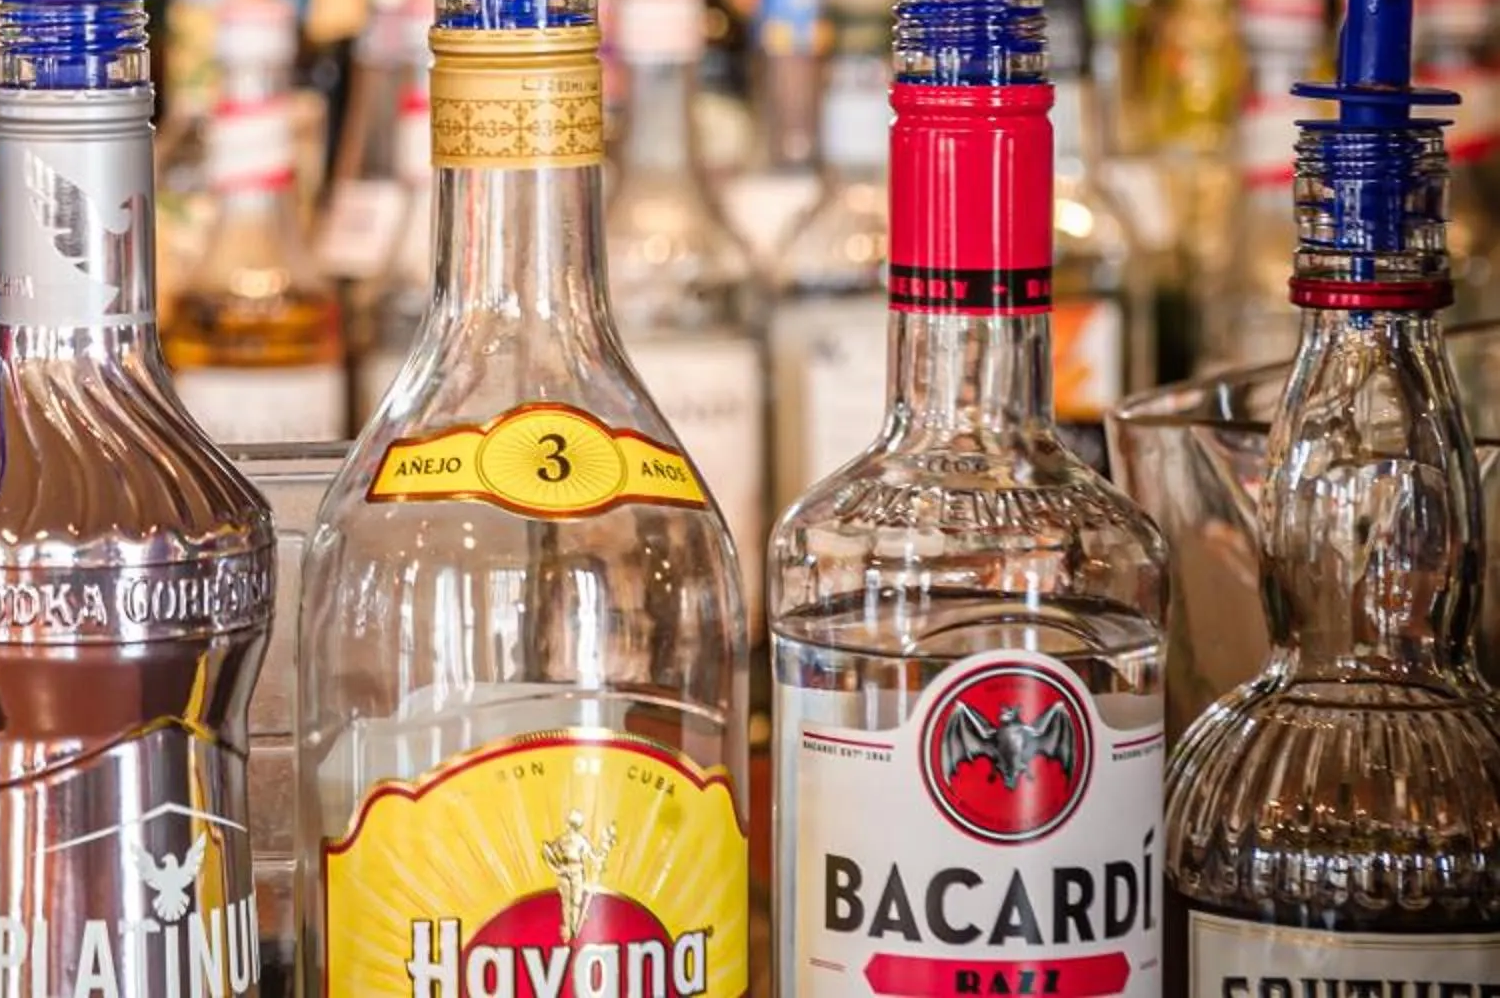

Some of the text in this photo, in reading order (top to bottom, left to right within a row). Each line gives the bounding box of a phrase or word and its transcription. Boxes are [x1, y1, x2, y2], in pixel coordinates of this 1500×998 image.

[394, 433, 687, 484] AÑEJO 3 AÑOS
[627, 765, 676, 798] CUBA
[825, 828, 1154, 946] BACARDÍ
[406, 918, 707, 998] Havana
[954, 969, 1060, 995] RAZZ
